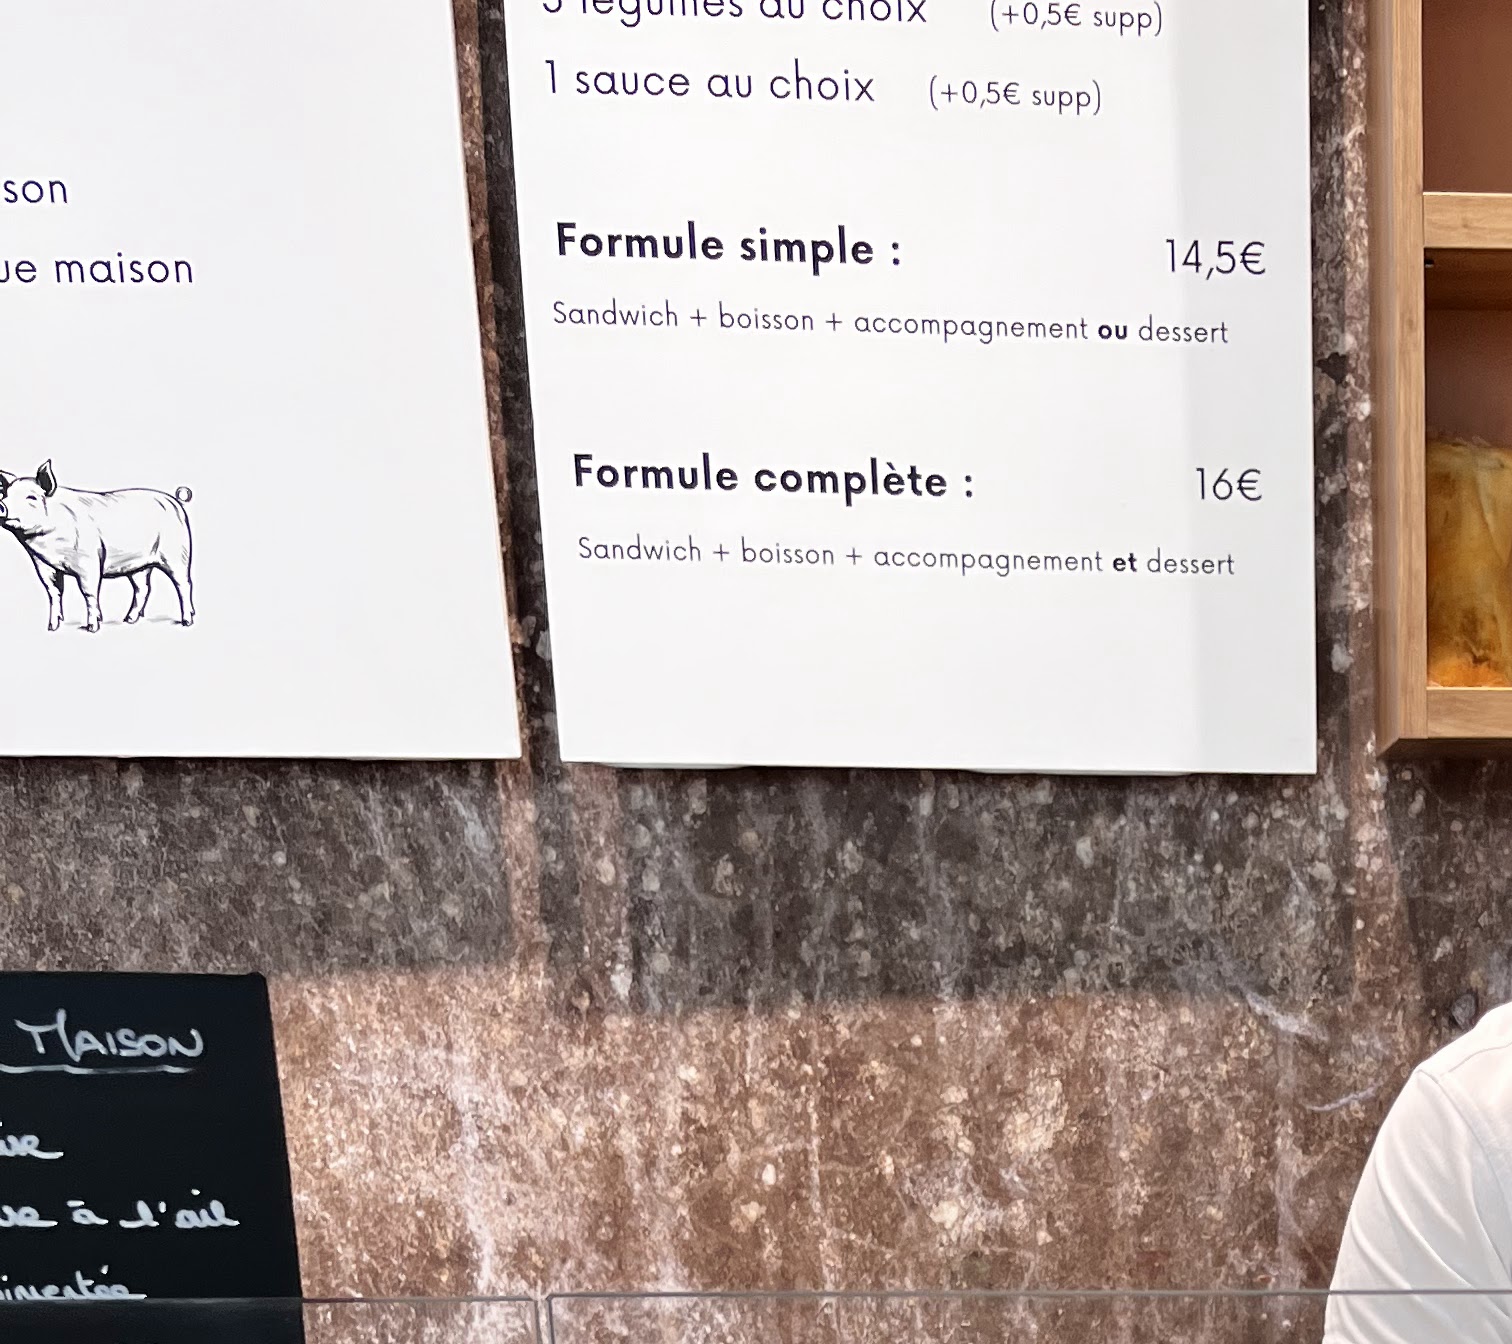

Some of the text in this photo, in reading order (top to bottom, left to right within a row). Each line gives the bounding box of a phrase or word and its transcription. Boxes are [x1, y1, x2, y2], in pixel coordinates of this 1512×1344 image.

[991, 0, 1082, 32] (+0,5€
[1093, 1, 1164, 36] supp)
[545, 58, 1102, 116] 1 sauce au choix (+0,5€ supp)
[55, 251, 193, 284] maison
[557, 220, 724, 260] Formule
[740, 224, 875, 277] simple
[1165, 238, 1266, 280] 14,5€
[553, 297, 678, 328] Sandwich
[719, 300, 814, 332] boisson
[854, 316, 1088, 345] accompagnement
[1098, 323, 1128, 341] ou
[1138, 314, 1229, 344] dessert
[573, 452, 739, 491] Formule
[754, 457, 947, 508] complète
[1196, 467, 1263, 502] 16€
[578, 534, 702, 563] Sandwich
[741, 536, 834, 566] boisson
[874, 548, 1103, 577] accompagnement
[1112, 553, 1138, 573] et
[1146, 547, 1235, 576] dessert
[66, 1200, 109, 1225] à
[0, 1264, 148, 1301] imentée
